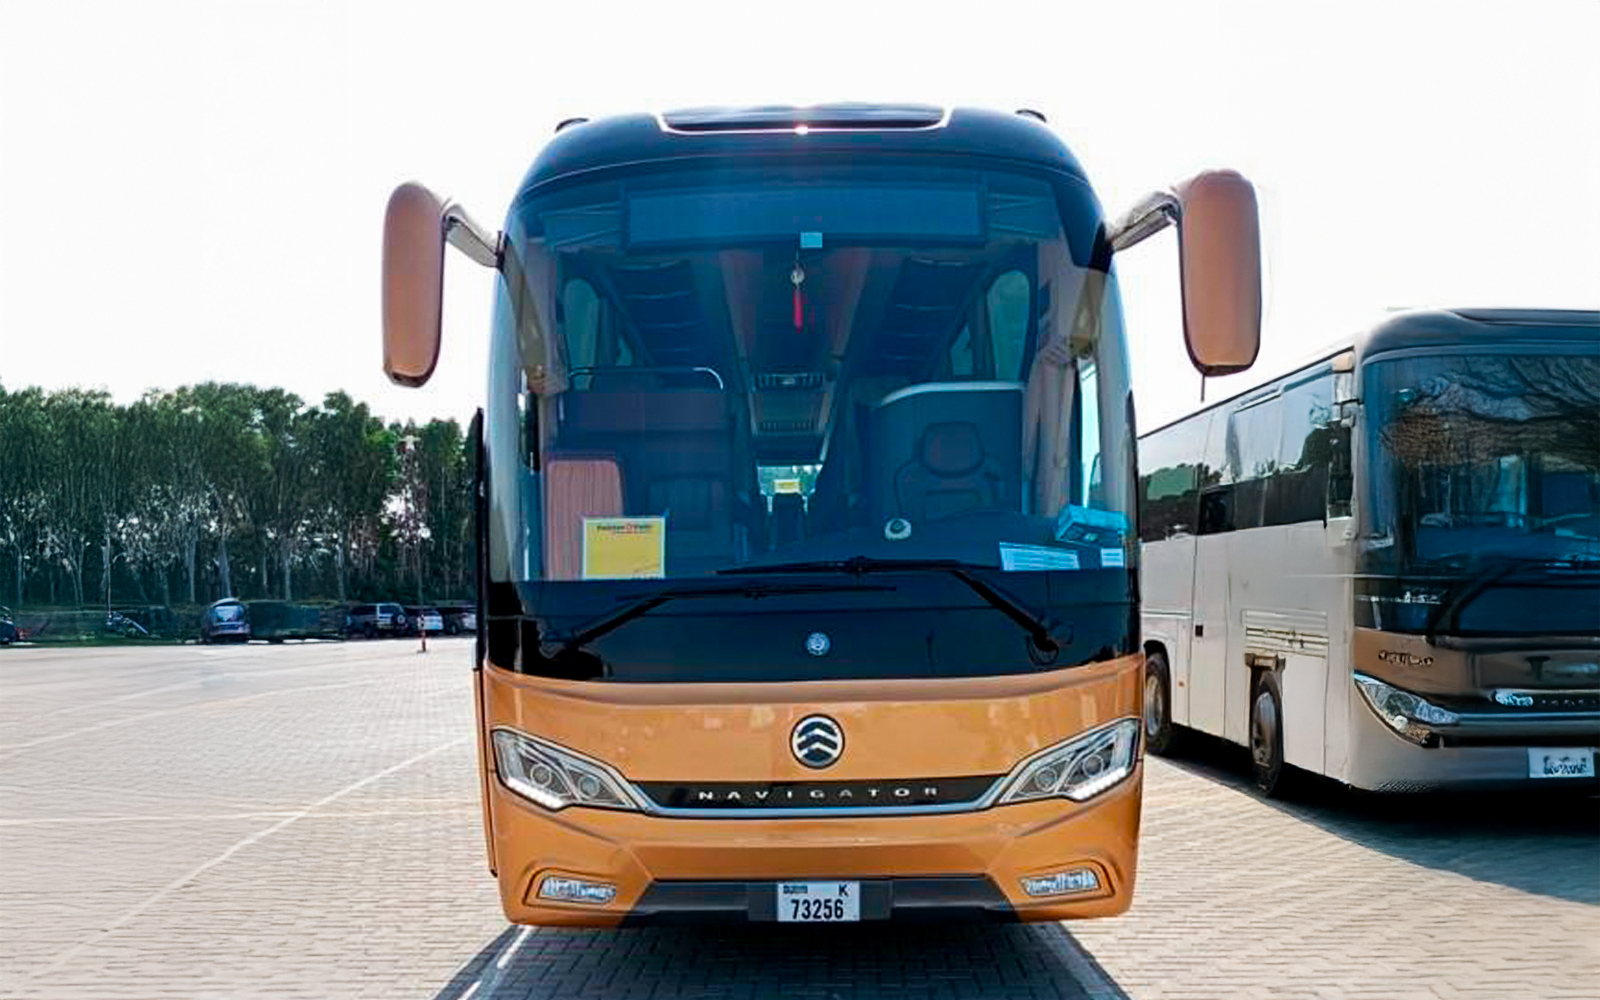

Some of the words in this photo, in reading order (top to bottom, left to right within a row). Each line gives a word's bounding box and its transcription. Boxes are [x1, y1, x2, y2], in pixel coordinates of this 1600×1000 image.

[698, 787, 938, 800] NAVIGATOR
[838, 883, 848, 896] K
[791, 899, 844, 919] 73256
